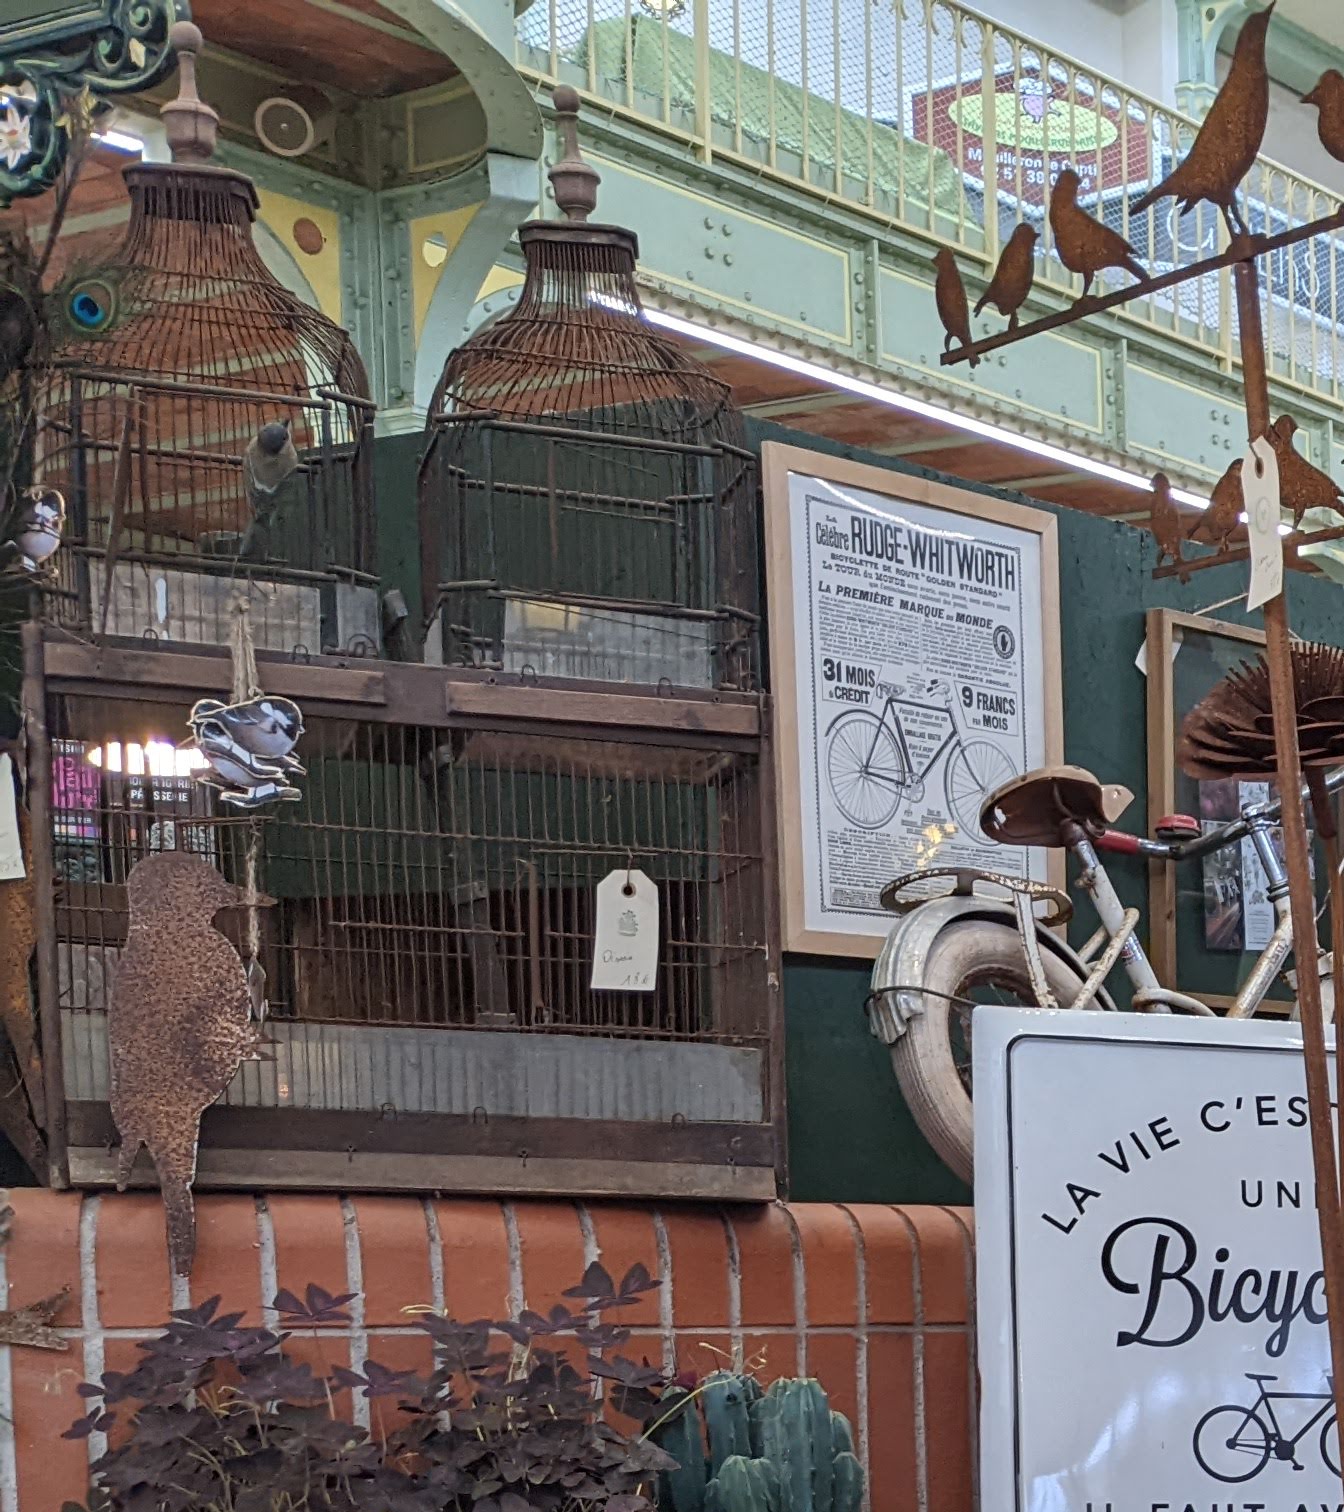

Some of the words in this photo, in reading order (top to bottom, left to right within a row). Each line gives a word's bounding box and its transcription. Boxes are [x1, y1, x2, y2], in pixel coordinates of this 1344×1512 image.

[830, 552, 879, 570] BICYCLETTE
[895, 567, 920, 580] ROUTE
[850, 515, 1016, 592] RUDGE-WHITWORTH
[836, 584, 894, 608] PREMIÈRE
[899, 599, 945, 620] MARQUE
[955, 612, 994, 630] MONDE
[822, 658, 842, 683] 31
[845, 665, 876, 689] MOIS
[961, 685, 973, 709] 9
[976, 691, 1016, 716] FRANCS
[982, 714, 1009, 731] MOIS
[1042, 1181, 1101, 1235] LA
[1097, 1115, 1182, 1176] VIE
[1200, 1095, 1340, 1132] C'ES
[1240, 1179, 1321, 1209] UN
